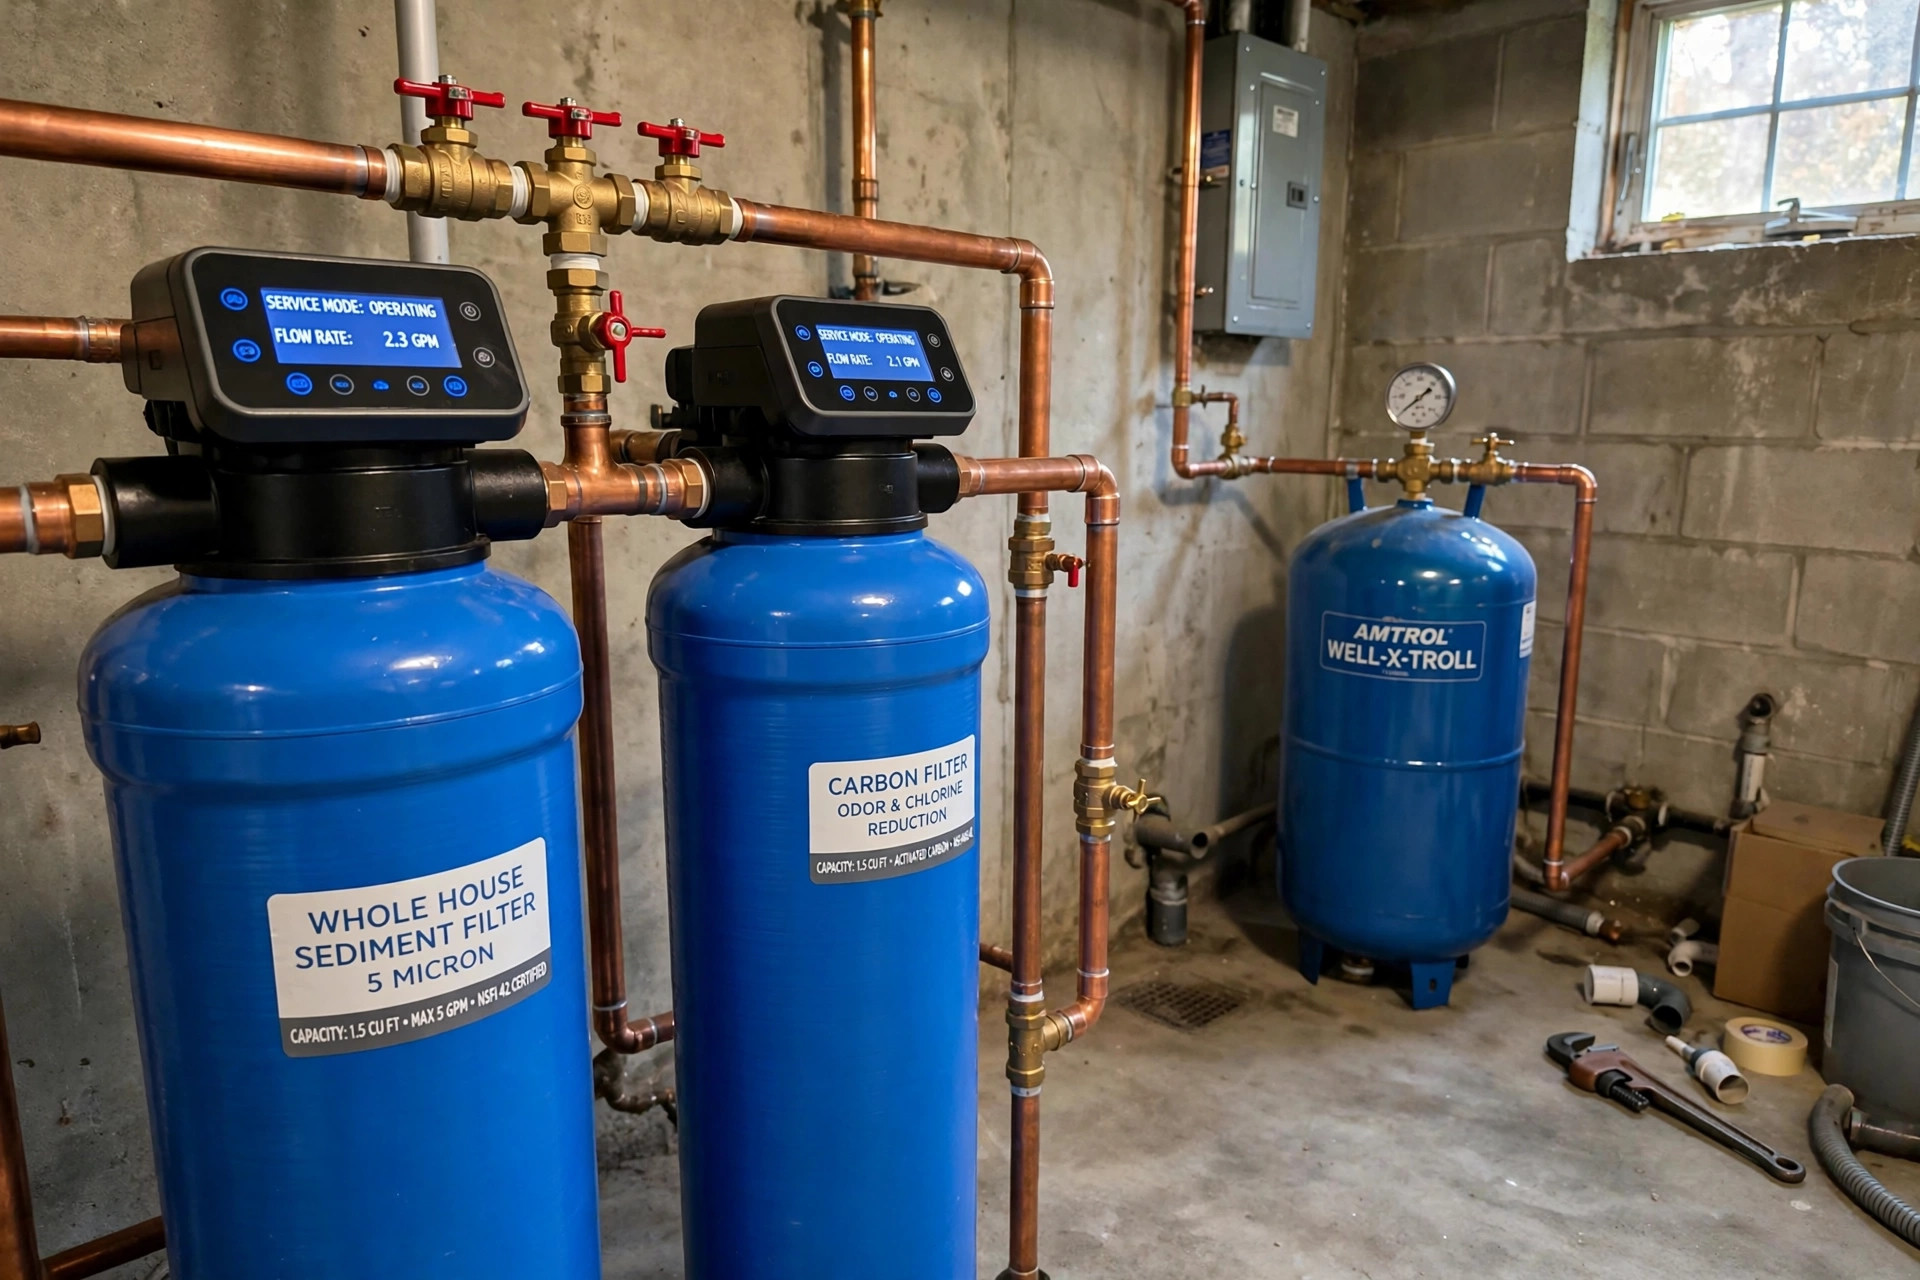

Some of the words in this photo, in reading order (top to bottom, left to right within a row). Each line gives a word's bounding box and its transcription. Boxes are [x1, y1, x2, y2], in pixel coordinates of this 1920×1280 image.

[265, 295, 322, 312] SERVICE
[323, 298, 364, 315] MODE:
[369, 300, 436, 318] OPERATING
[274, 328, 312, 344] FLOW
[315, 329, 353, 345] RATE:
[383, 331, 409, 348] 2.3
[411, 333, 439, 349] GPM
[818, 329, 850, 341] SERVICE
[849, 331, 874, 342] MODE:
[875, 332, 915, 345] OPERATING
[826, 353, 850, 365] FLOW
[850, 354, 873, 366] RATE:
[886, 355, 902, 367] 2.1
[903, 356, 920, 367] GPM
[1353, 623, 1449, 645] AMTROL
[1327, 639, 1477, 670] WELL-X-TROLL
[828, 768, 918, 796] CARBON
[924, 753, 968, 783] FILTER
[838, 800, 886, 817] ODOR
[891, 798, 901, 812] &
[905, 780, 963, 809] CHLORINE
[868, 807, 947, 836] REDUCTION
[816, 860, 855, 874] CAPACITY:
[857, 859, 867, 871] 1.5
[308, 896, 428, 935] WHOLE
[438, 865, 524, 914] HOUSE
[295, 922, 454, 969] SEDIMENT
[463, 891, 536, 939] FILTER
[368, 972, 383, 993] 5
[393, 942, 494, 989] MICRON
[290, 1025, 348, 1044] CAPACITY:
[350, 1023, 366, 1039] 1.5
[368, 1020, 384, 1036] CU
[386, 1016, 400, 1033] FT
[411, 1008, 435, 1027] MAX
[437, 1005, 444, 1020] 5
[446, 997, 468, 1018] GPM
[499, 981, 511, 997] 42
[511, 961, 547, 992] CERTIFIED
